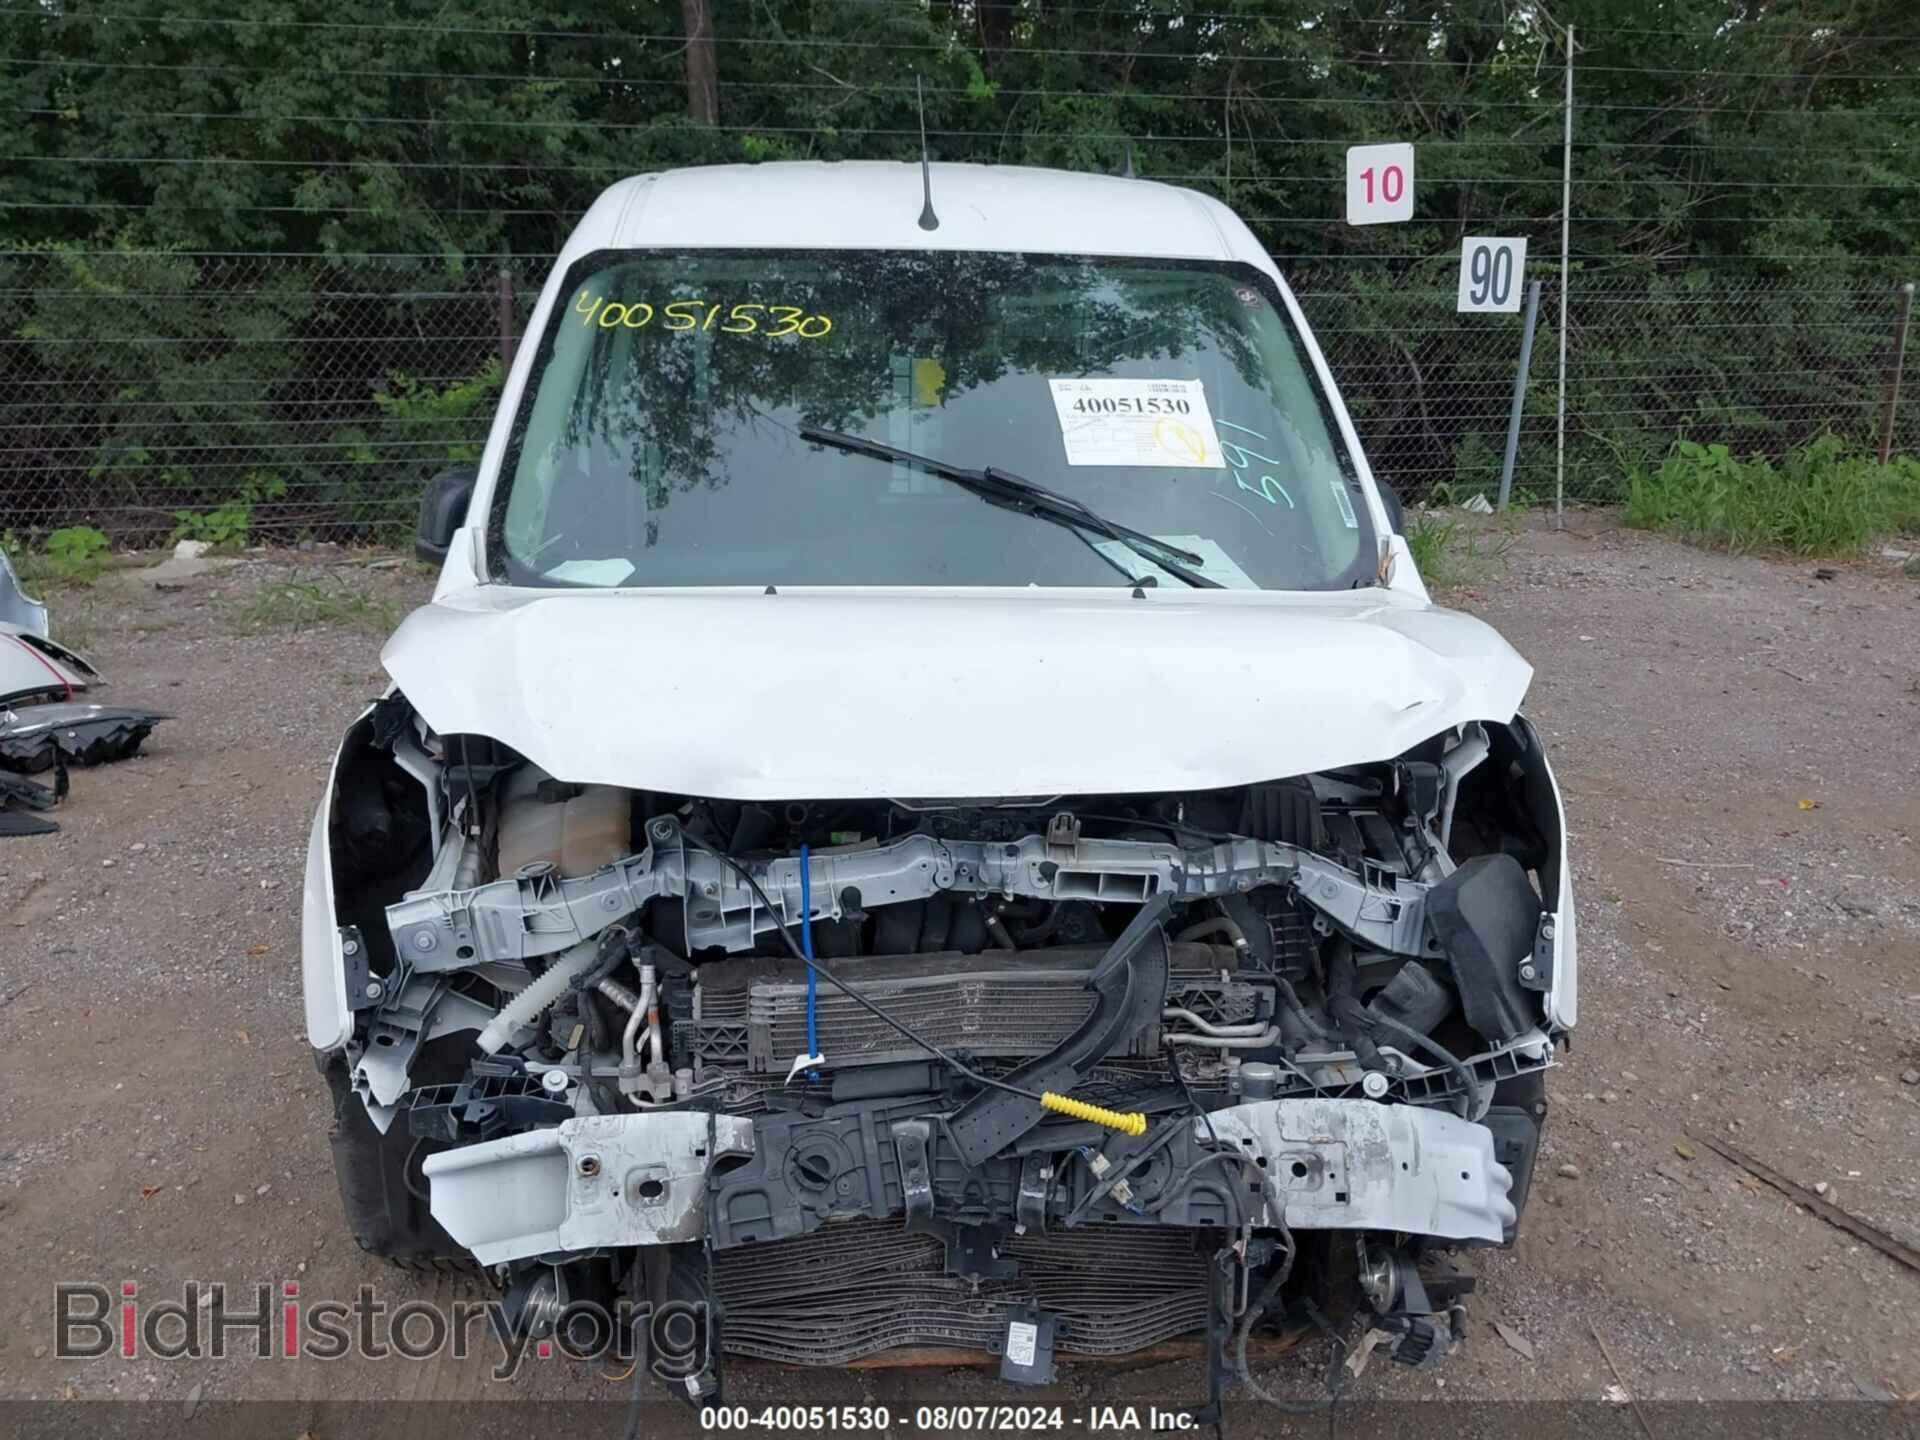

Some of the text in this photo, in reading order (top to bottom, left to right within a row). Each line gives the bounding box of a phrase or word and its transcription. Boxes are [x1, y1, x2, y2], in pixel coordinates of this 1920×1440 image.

[1360, 165, 1404, 204] 10
[1470, 245, 1513, 306] 90
[1073, 397, 1191, 415] 40051530
